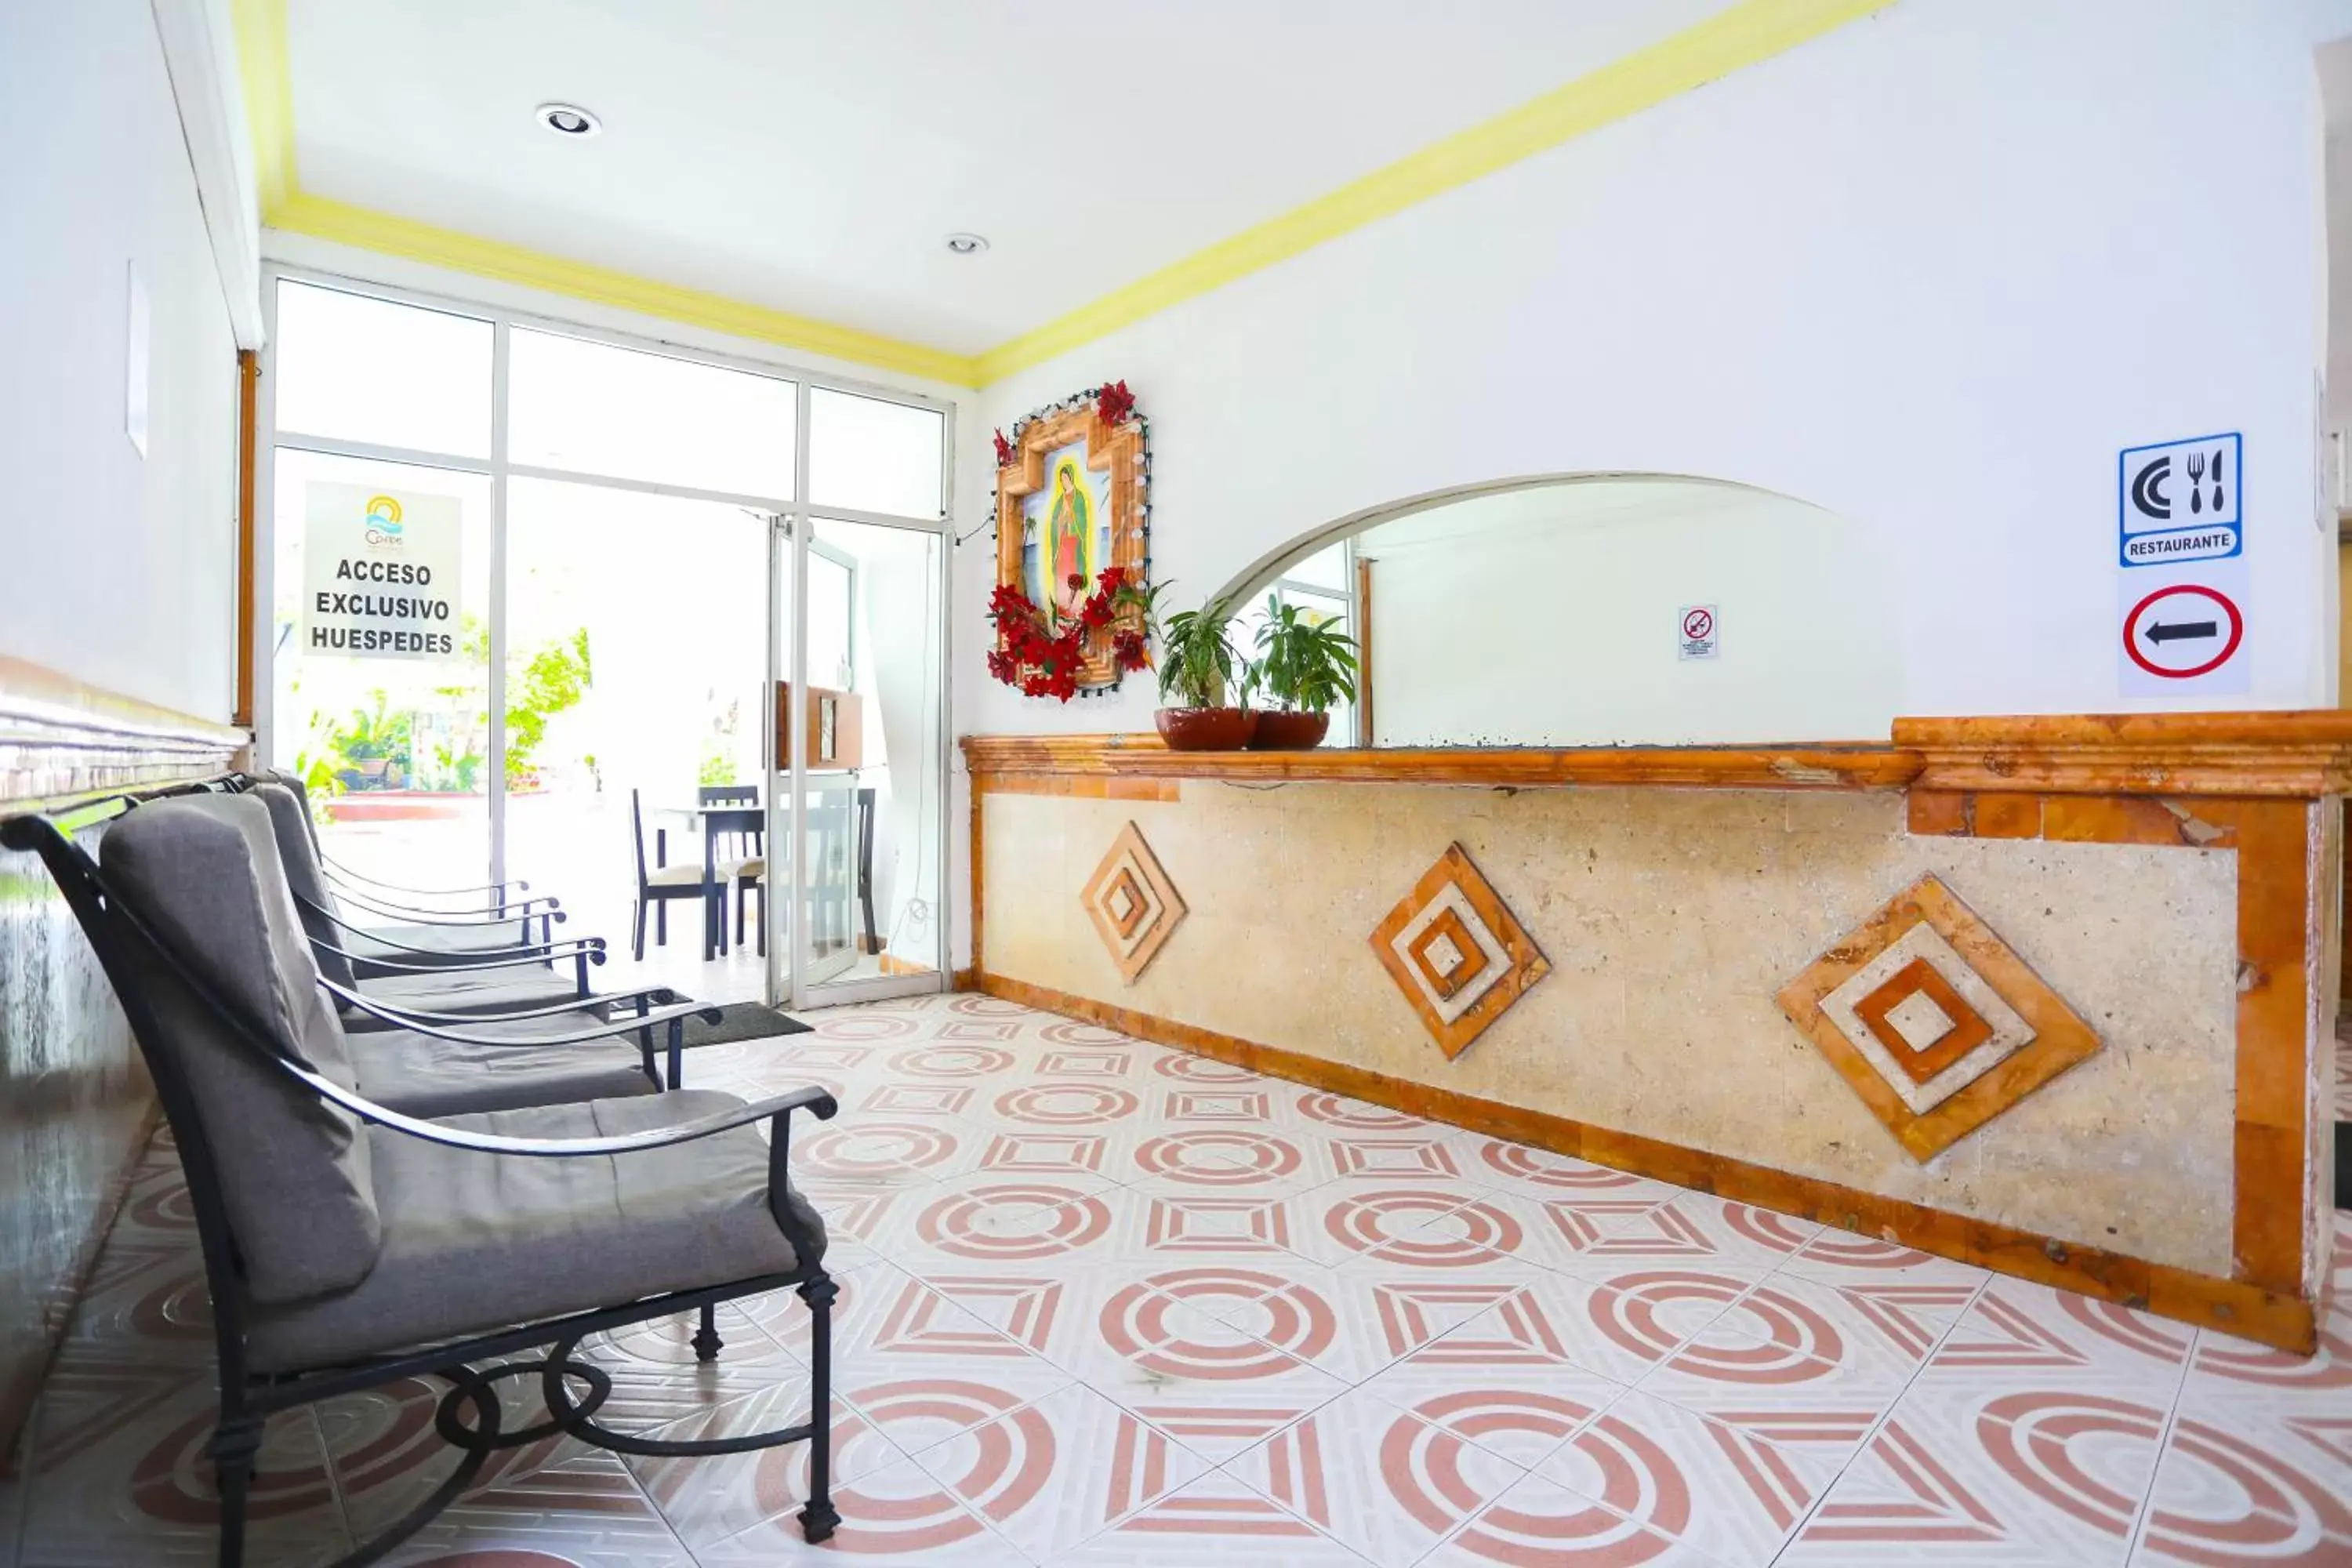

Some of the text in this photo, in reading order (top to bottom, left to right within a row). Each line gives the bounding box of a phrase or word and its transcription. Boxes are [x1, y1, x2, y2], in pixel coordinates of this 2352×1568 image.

[2130, 533, 2230, 556] RESTAURANTE
[336, 559, 431, 586] ACCESO
[316, 592, 449, 621] EXCLUSIVO
[312, 626, 452, 654] HUESPEDES
